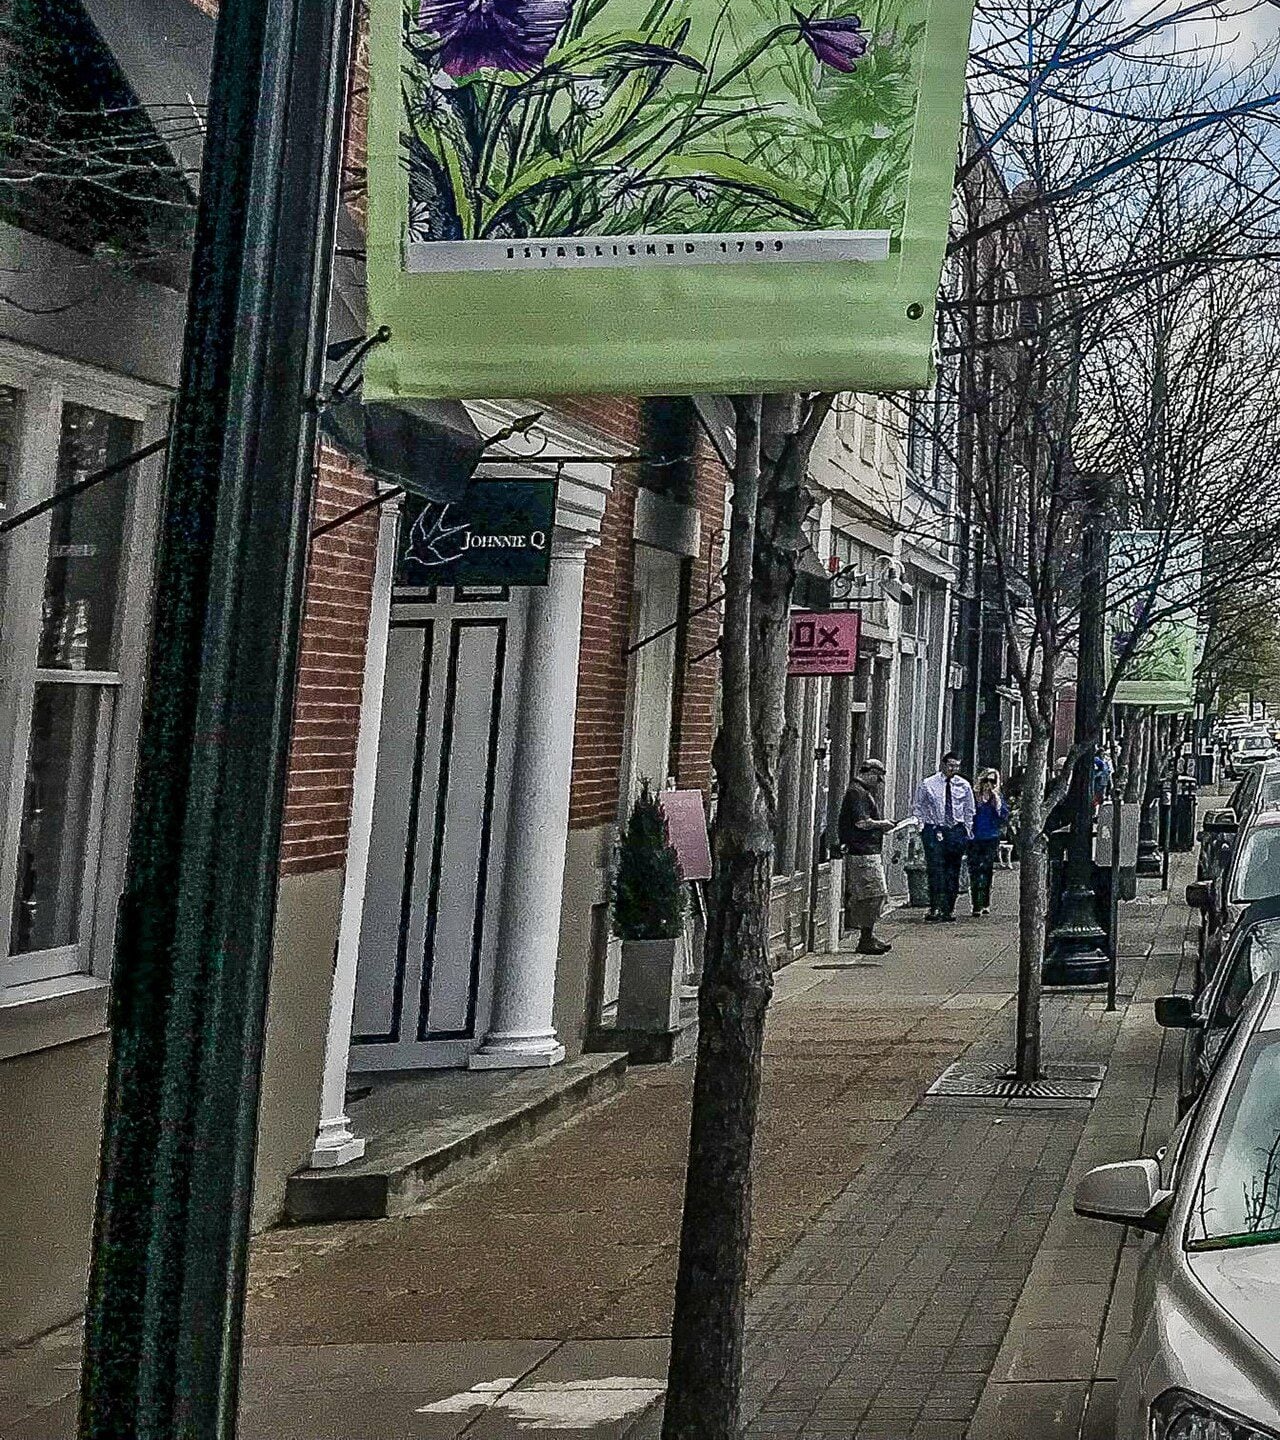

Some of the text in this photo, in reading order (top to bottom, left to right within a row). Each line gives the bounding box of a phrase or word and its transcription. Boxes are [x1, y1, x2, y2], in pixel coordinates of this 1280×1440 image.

[506, 240, 784, 258] ESTABLISHED 1799
[530, 530, 546, 550] Q
